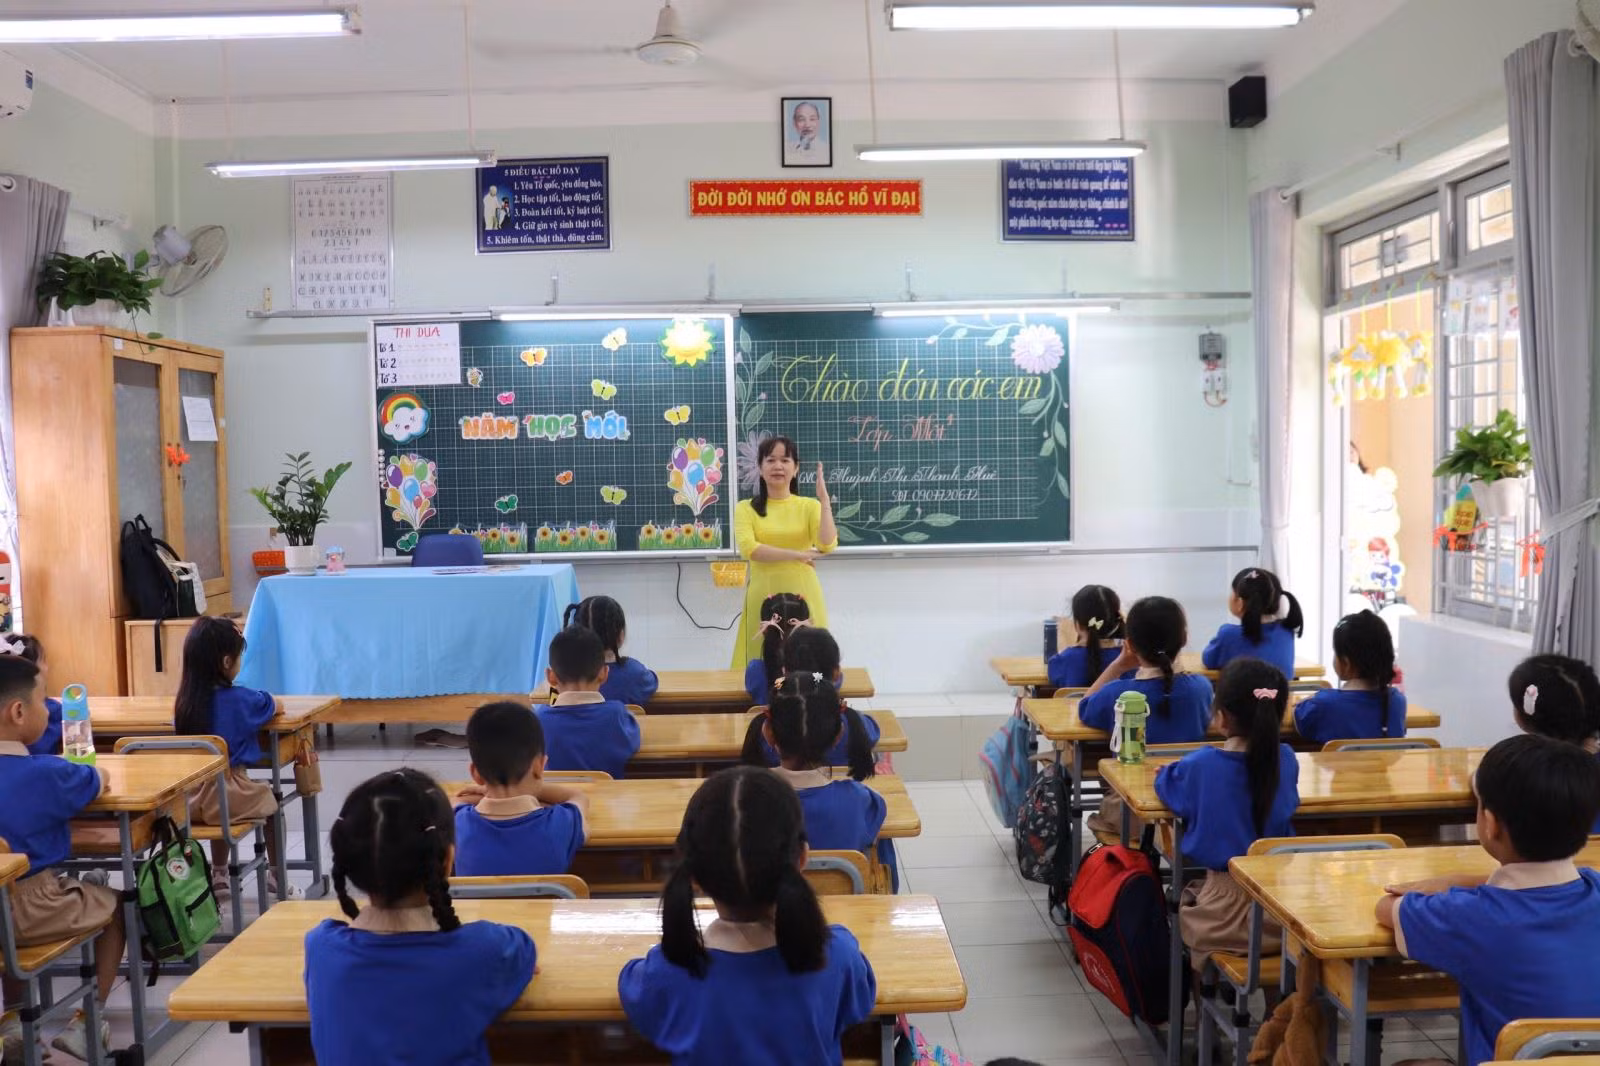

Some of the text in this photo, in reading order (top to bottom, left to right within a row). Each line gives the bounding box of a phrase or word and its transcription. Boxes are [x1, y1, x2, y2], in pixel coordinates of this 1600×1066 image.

[510, 166, 530, 175] ĐIỀU
[532, 166, 548, 175] BÁC
[550, 165, 561, 175] HỒ
[563, 167, 580, 175] DẠY
[521, 182, 533, 190] Yêu
[535, 179, 543, 189] Tổ
[562, 182, 572, 191] yêu
[522, 195, 535, 204] Học
[537, 194, 547, 204] tập
[562, 194, 572, 202] lao
[573, 193, 590, 204] động
[698, 186, 915, 208] ĐỜI ĐỜI NHỚ ƠN BÁC HỒ VĨ ĐẠI
[522, 208, 539, 216] Đoàn
[542, 206, 552, 216] kết
[577, 206, 590, 215] luật
[522, 222, 536, 230] Giữ
[550, 222, 557, 231] vệ
[560, 221, 574, 229] sinh
[576, 220, 589, 229] thật
[495, 235, 518, 244] Khiêm
[520, 233, 535, 244] tốn,
[536, 234, 550, 245] thật
[568, 233, 585, 243] dũng
[587, 231, 603, 242] cảm.
[394, 327, 411, 338] THI
[389, 343, 395, 352] 1
[390, 359, 396, 368] 2
[391, 374, 397, 383] 3
[879, 357, 938, 401] đón
[947, 368, 994, 400] các
[997, 376, 1041, 400] em
[462, 410, 627, 441] NĂM HỌC MỚI
